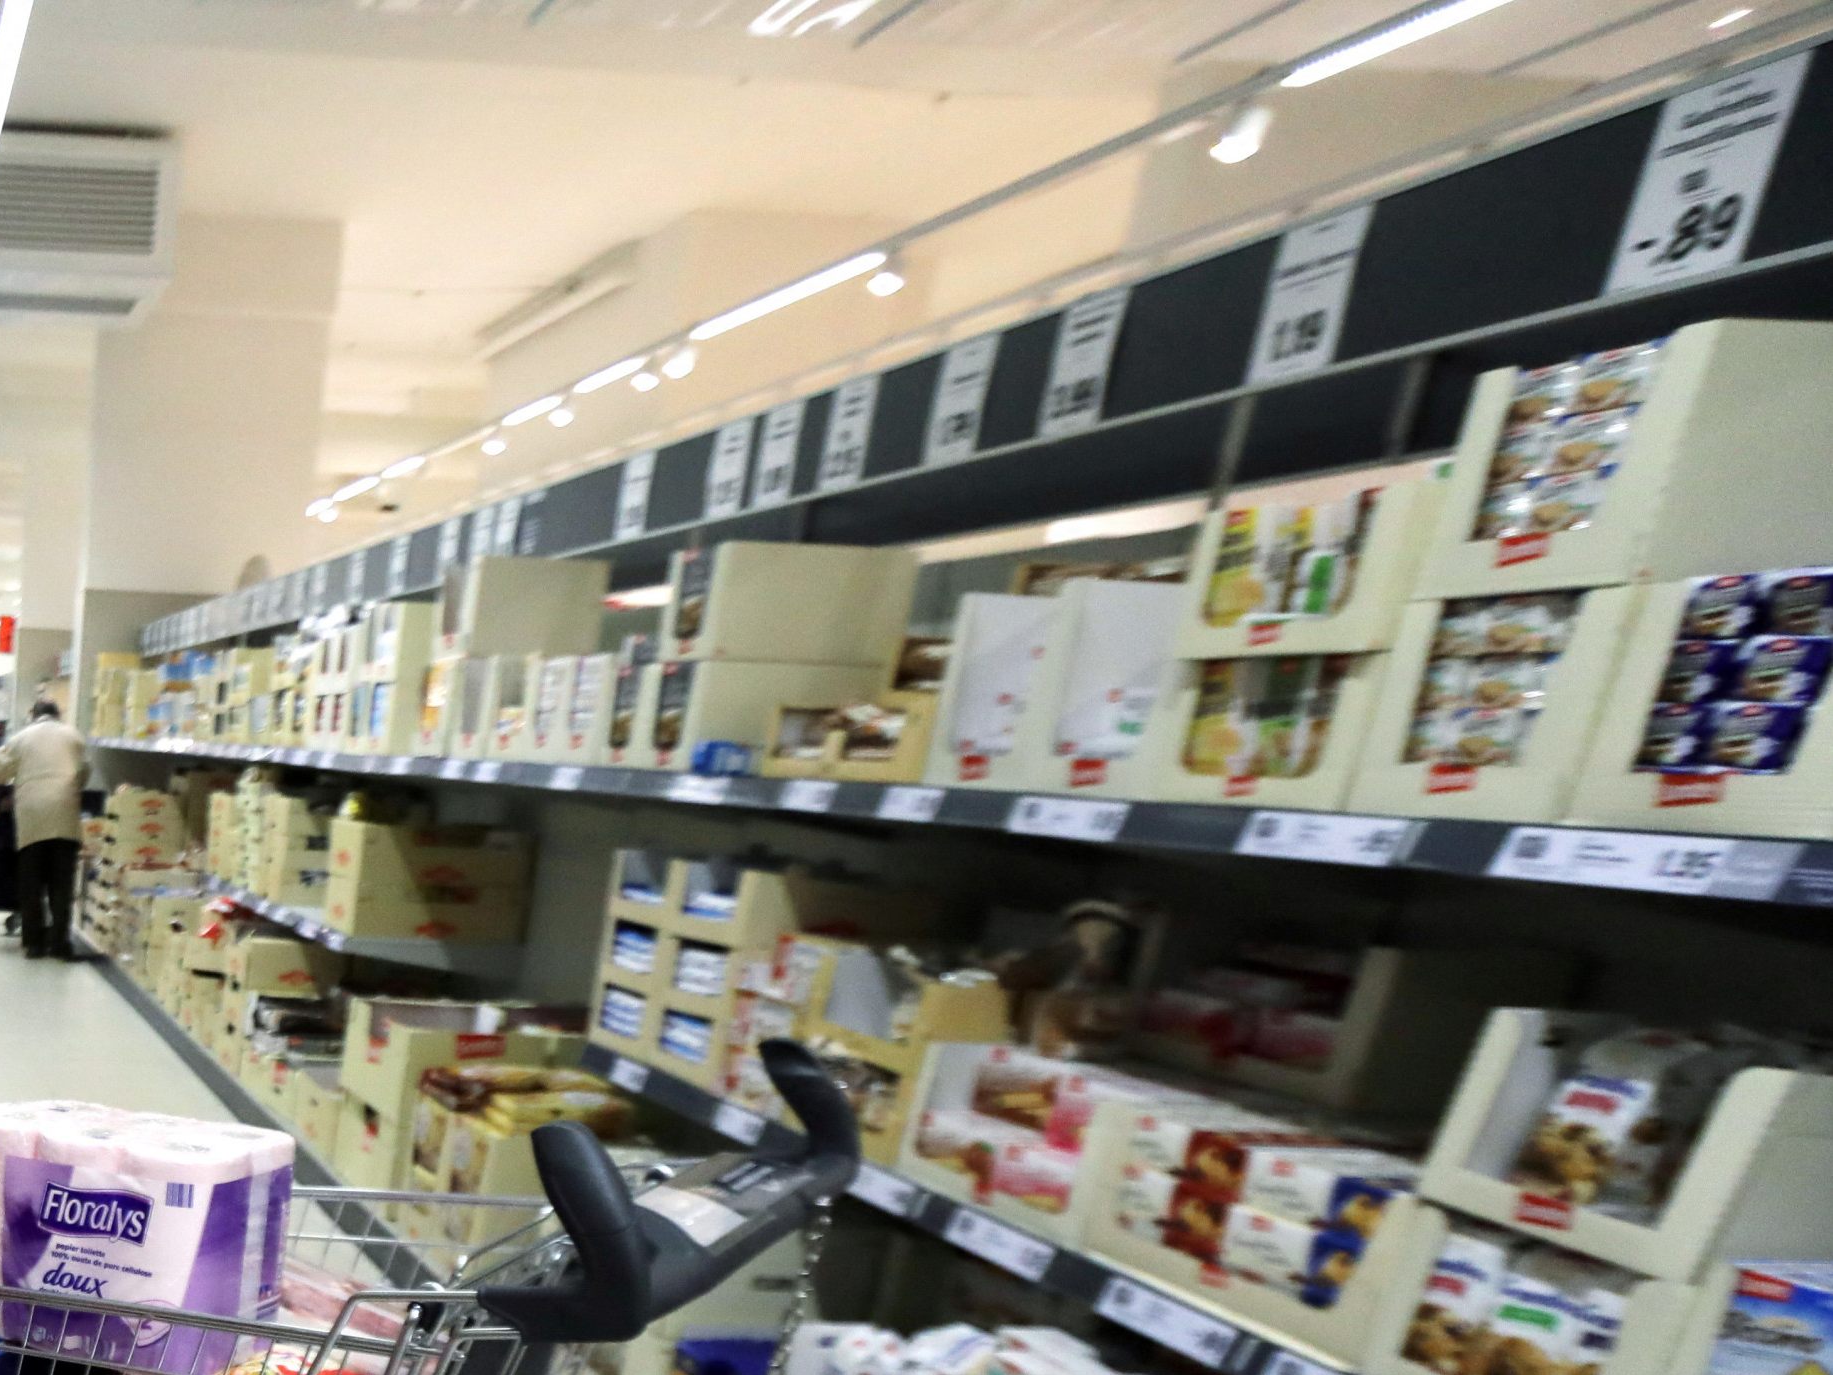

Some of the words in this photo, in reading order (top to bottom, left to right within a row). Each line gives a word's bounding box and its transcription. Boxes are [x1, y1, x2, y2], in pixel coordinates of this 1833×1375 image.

[43, 1188, 146, 1242] Floralys
[56, 1242, 79, 1254] papier
[80, 1246, 106, 1258] toilette
[42, 1261, 110, 1299] doux
[121, 1264, 153, 1278] cellulose
